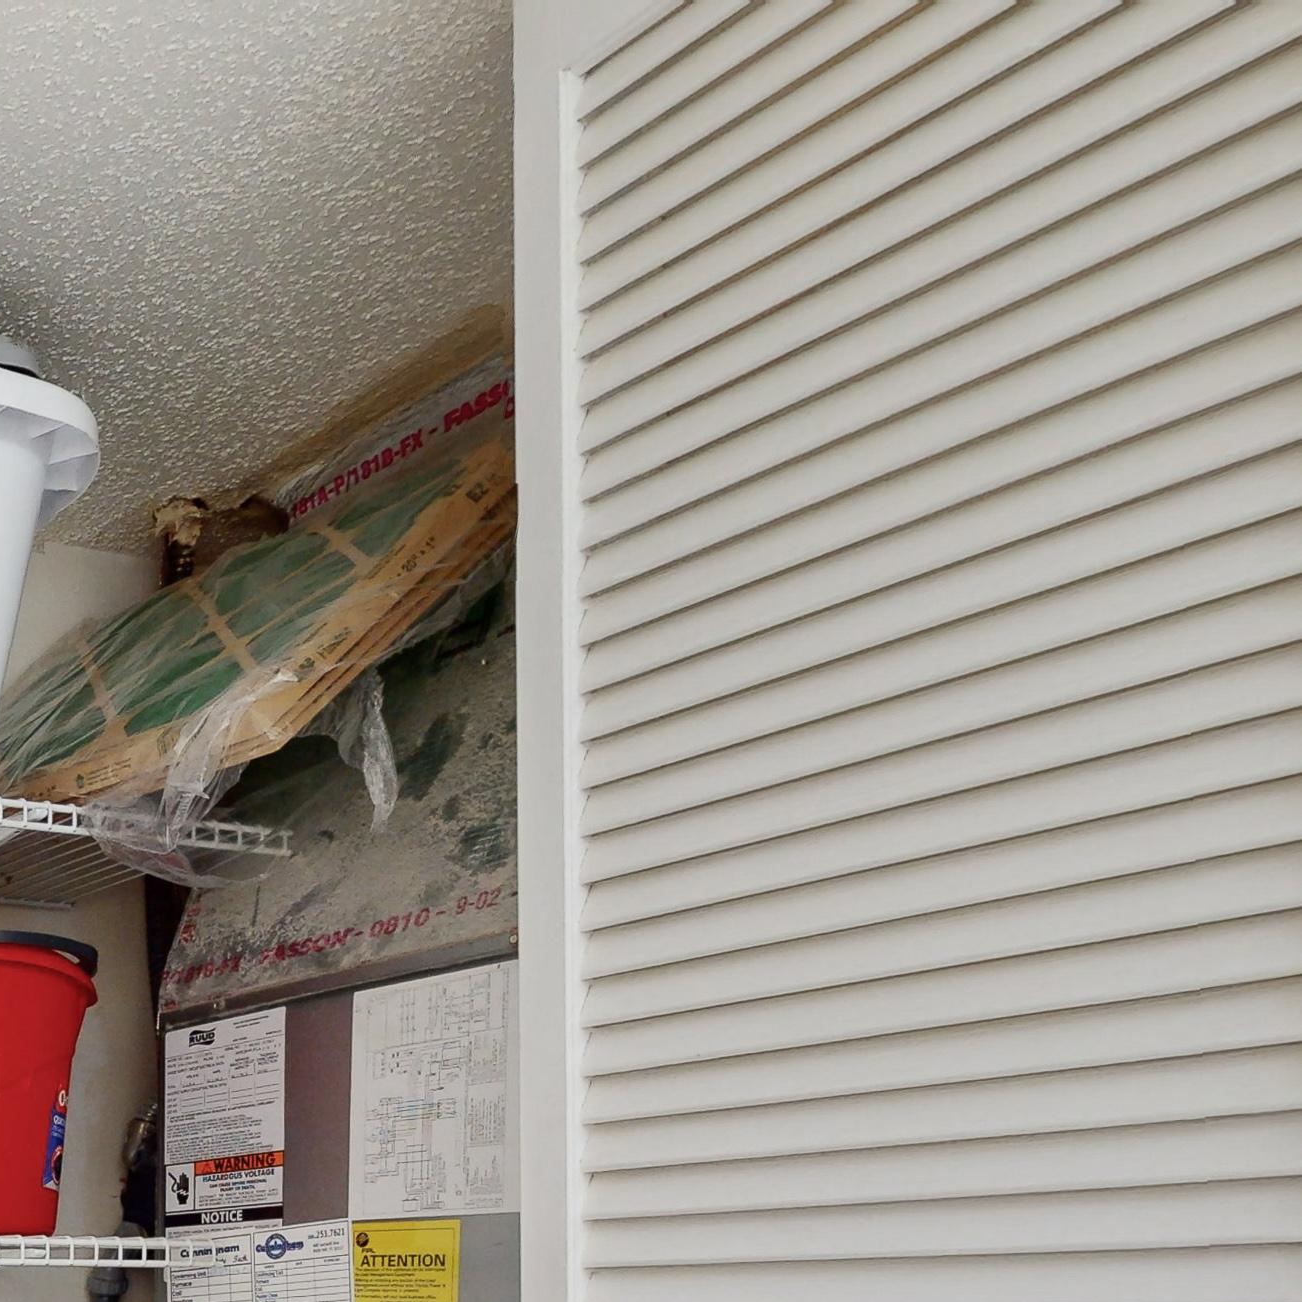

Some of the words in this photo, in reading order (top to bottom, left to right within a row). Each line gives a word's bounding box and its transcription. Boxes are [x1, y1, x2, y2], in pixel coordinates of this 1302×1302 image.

[188, 1031, 216, 1044] RUUD
[213, 1153, 276, 1172] WARNING
[202, 1172, 243, 1183] HAZARDOUS
[244, 1168, 275, 1179] VOLTAGE
[201, 1209, 244, 1225] NOTICE
[360, 1253, 447, 1268] ATTENTION
